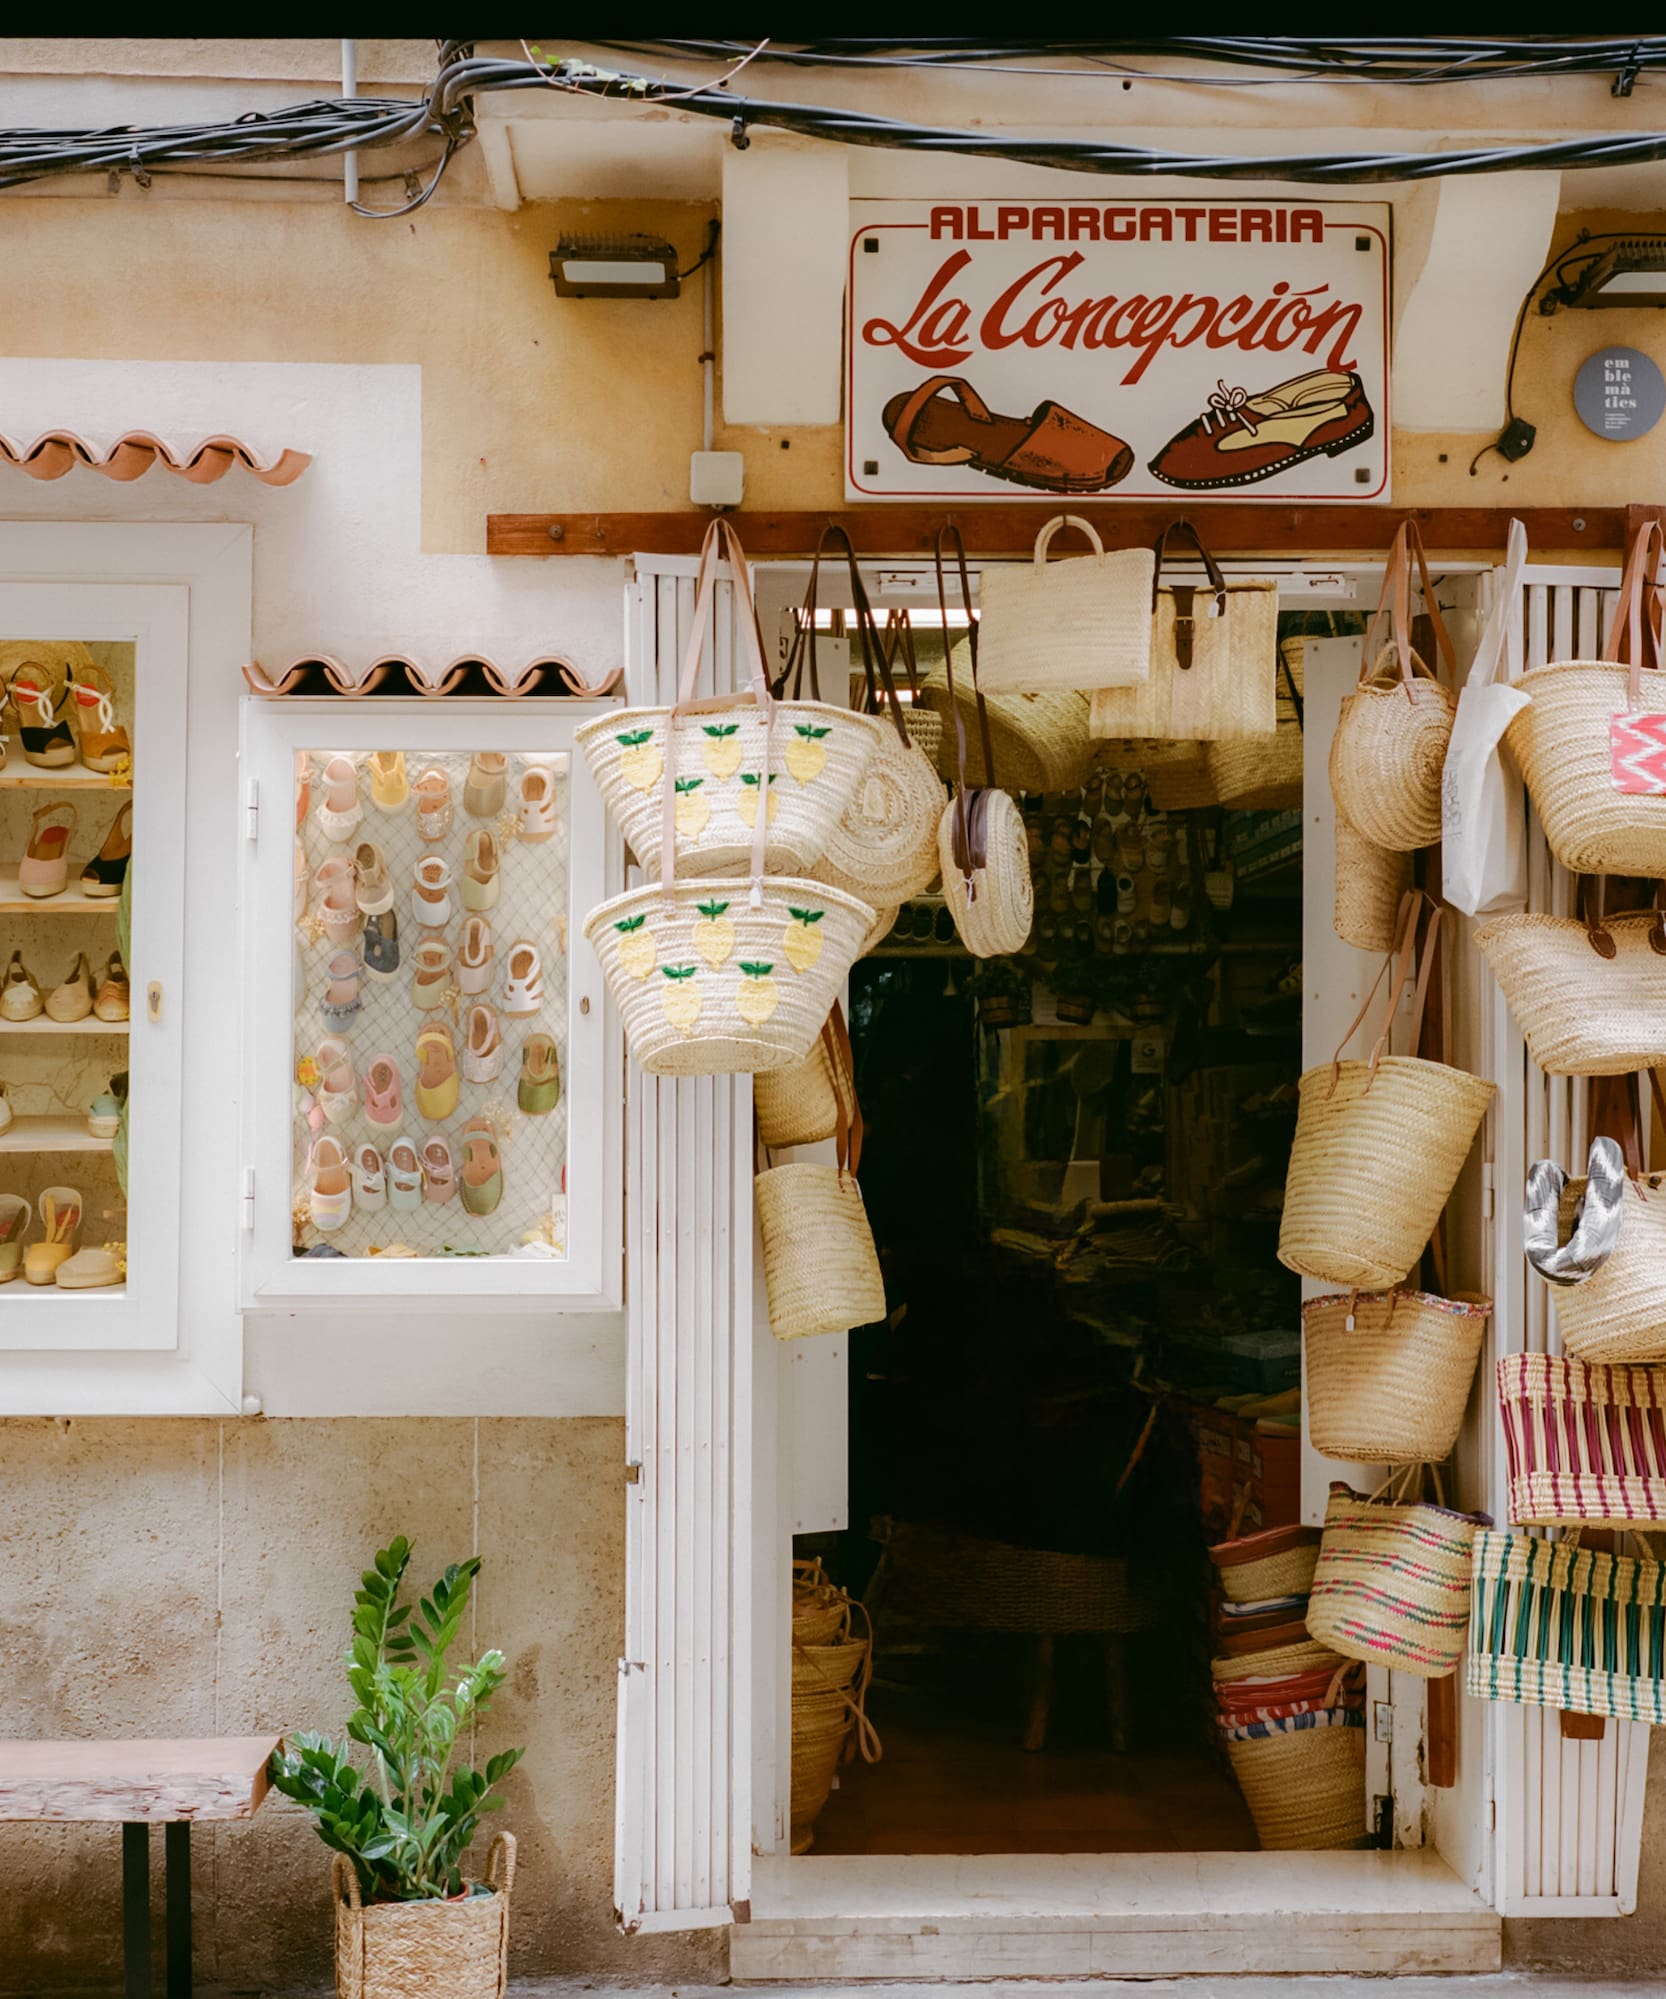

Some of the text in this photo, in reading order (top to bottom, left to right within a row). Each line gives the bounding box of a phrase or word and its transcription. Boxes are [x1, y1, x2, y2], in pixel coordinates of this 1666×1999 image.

[930, 206, 1326, 243] ALPARGATERIA
[862, 248, 1364, 386] La Concepción
[1604, 359, 1630, 369] em
[1604, 369, 1632, 382] ble
[1604, 382, 1631, 395] mà
